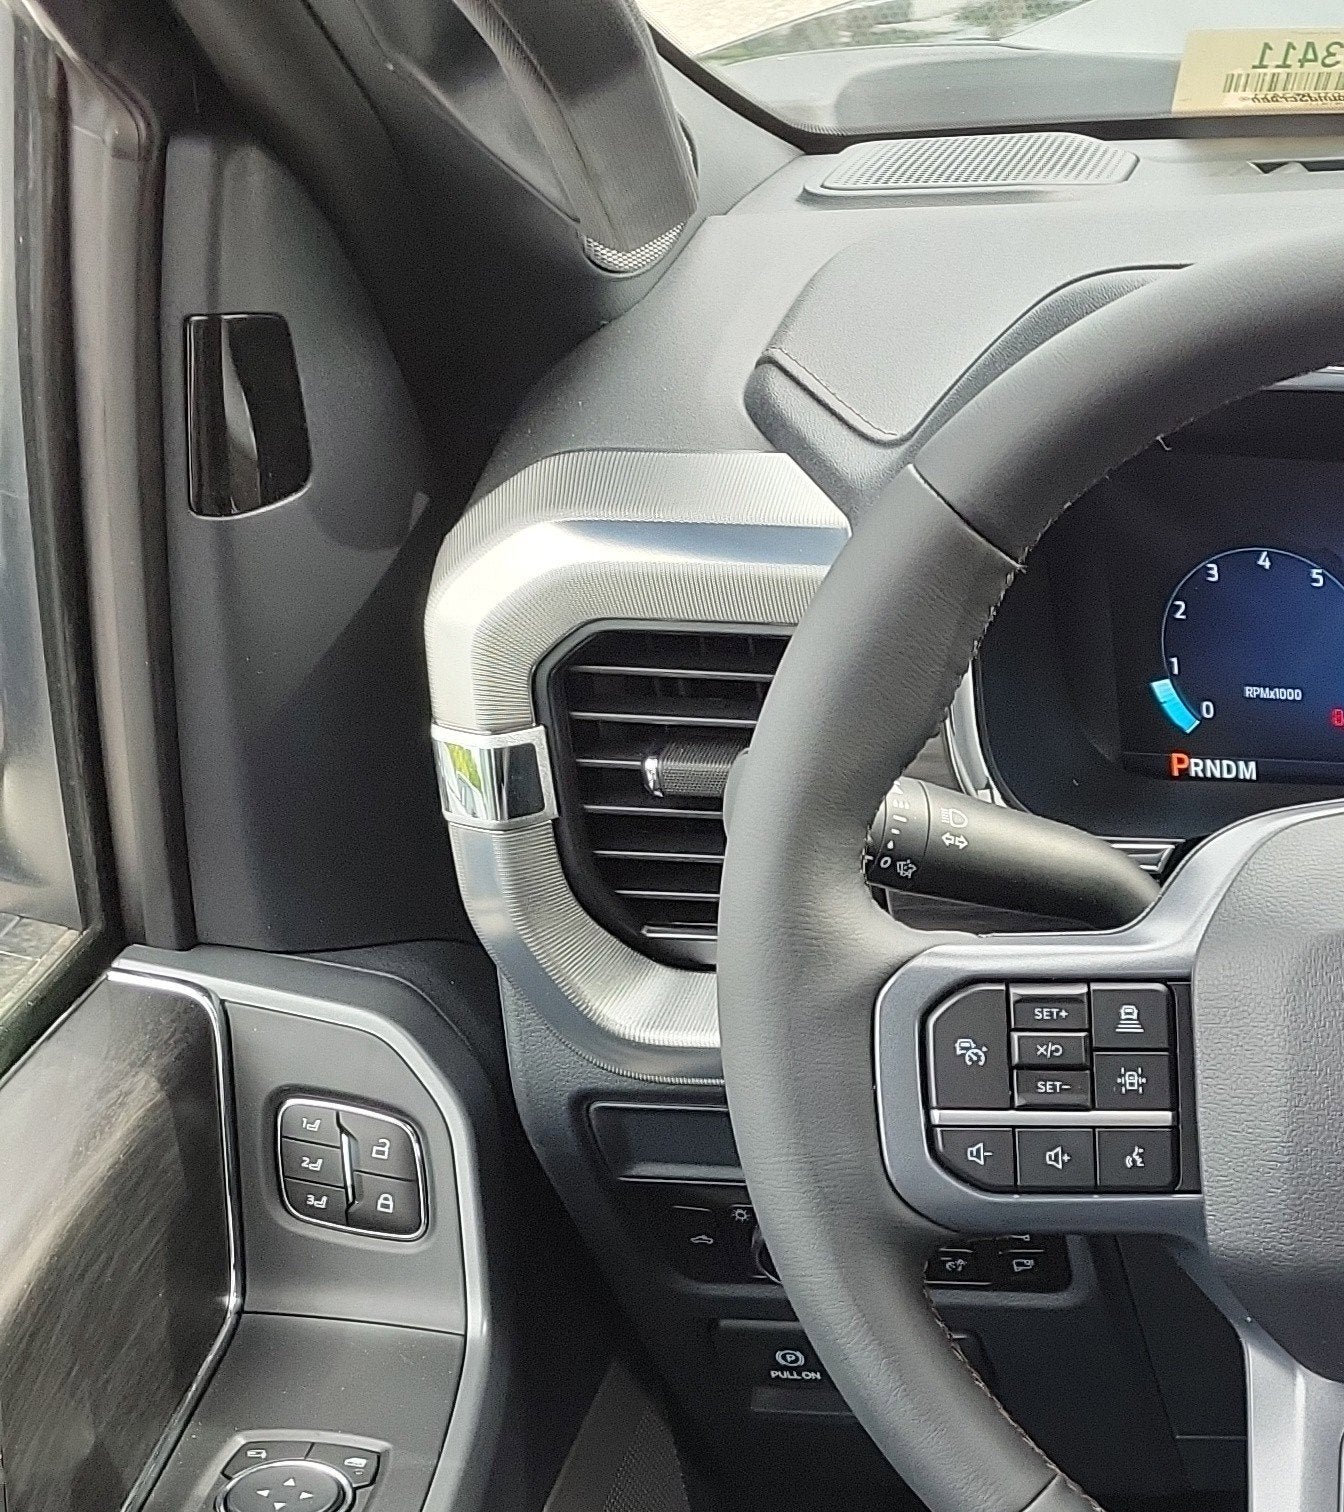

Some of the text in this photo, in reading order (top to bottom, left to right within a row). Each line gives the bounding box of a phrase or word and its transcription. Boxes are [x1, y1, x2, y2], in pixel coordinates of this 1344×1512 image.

[1257, 551, 1271, 569] 4
[1205, 563, 1219, 582] 3
[1310, 569, 1324, 587] 5
[1173, 601, 1186, 619] 2
[1169, 657, 1179, 675] 1
[1244, 686, 1302, 701] RPMx1000
[1202, 700, 1215, 718] 0
[301, 1156, 309, 1167] 2
[306, 1194, 314, 1205] 3
[770, 1370, 821, 1380] PULL ON
